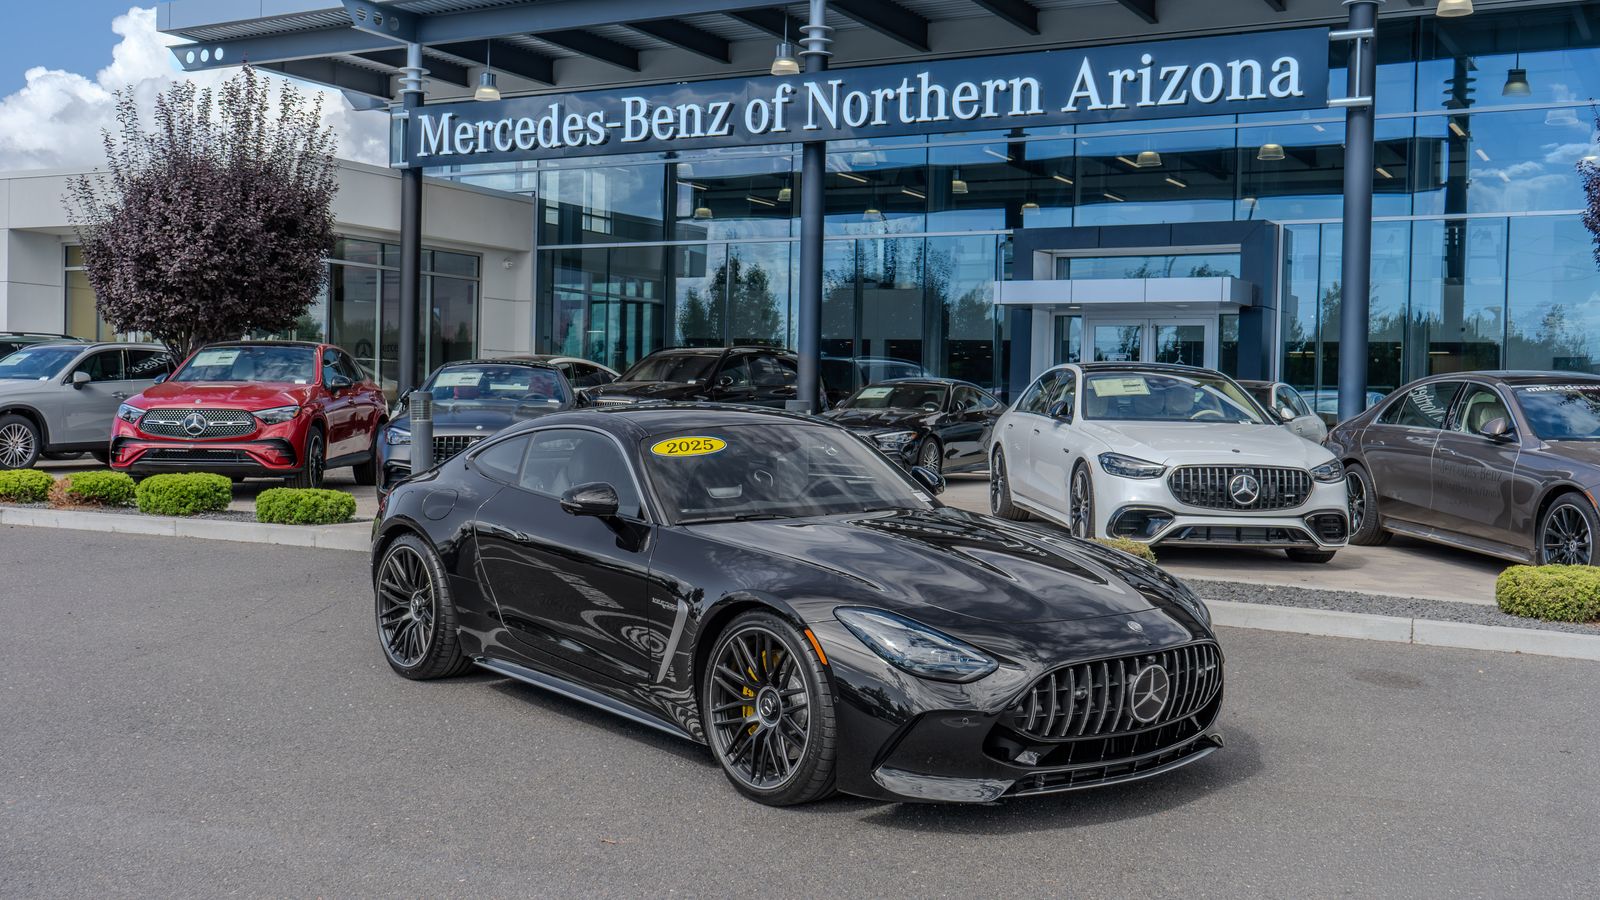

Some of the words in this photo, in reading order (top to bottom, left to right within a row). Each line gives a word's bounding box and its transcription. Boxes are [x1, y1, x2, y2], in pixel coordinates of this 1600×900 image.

[417, 96, 731, 157] Mercedes-Benz
[743, 84, 793, 133] of
[803, 73, 1042, 130] Northern
[1061, 53, 1304, 113] Arizona
[666, 439, 714, 454] 2025
